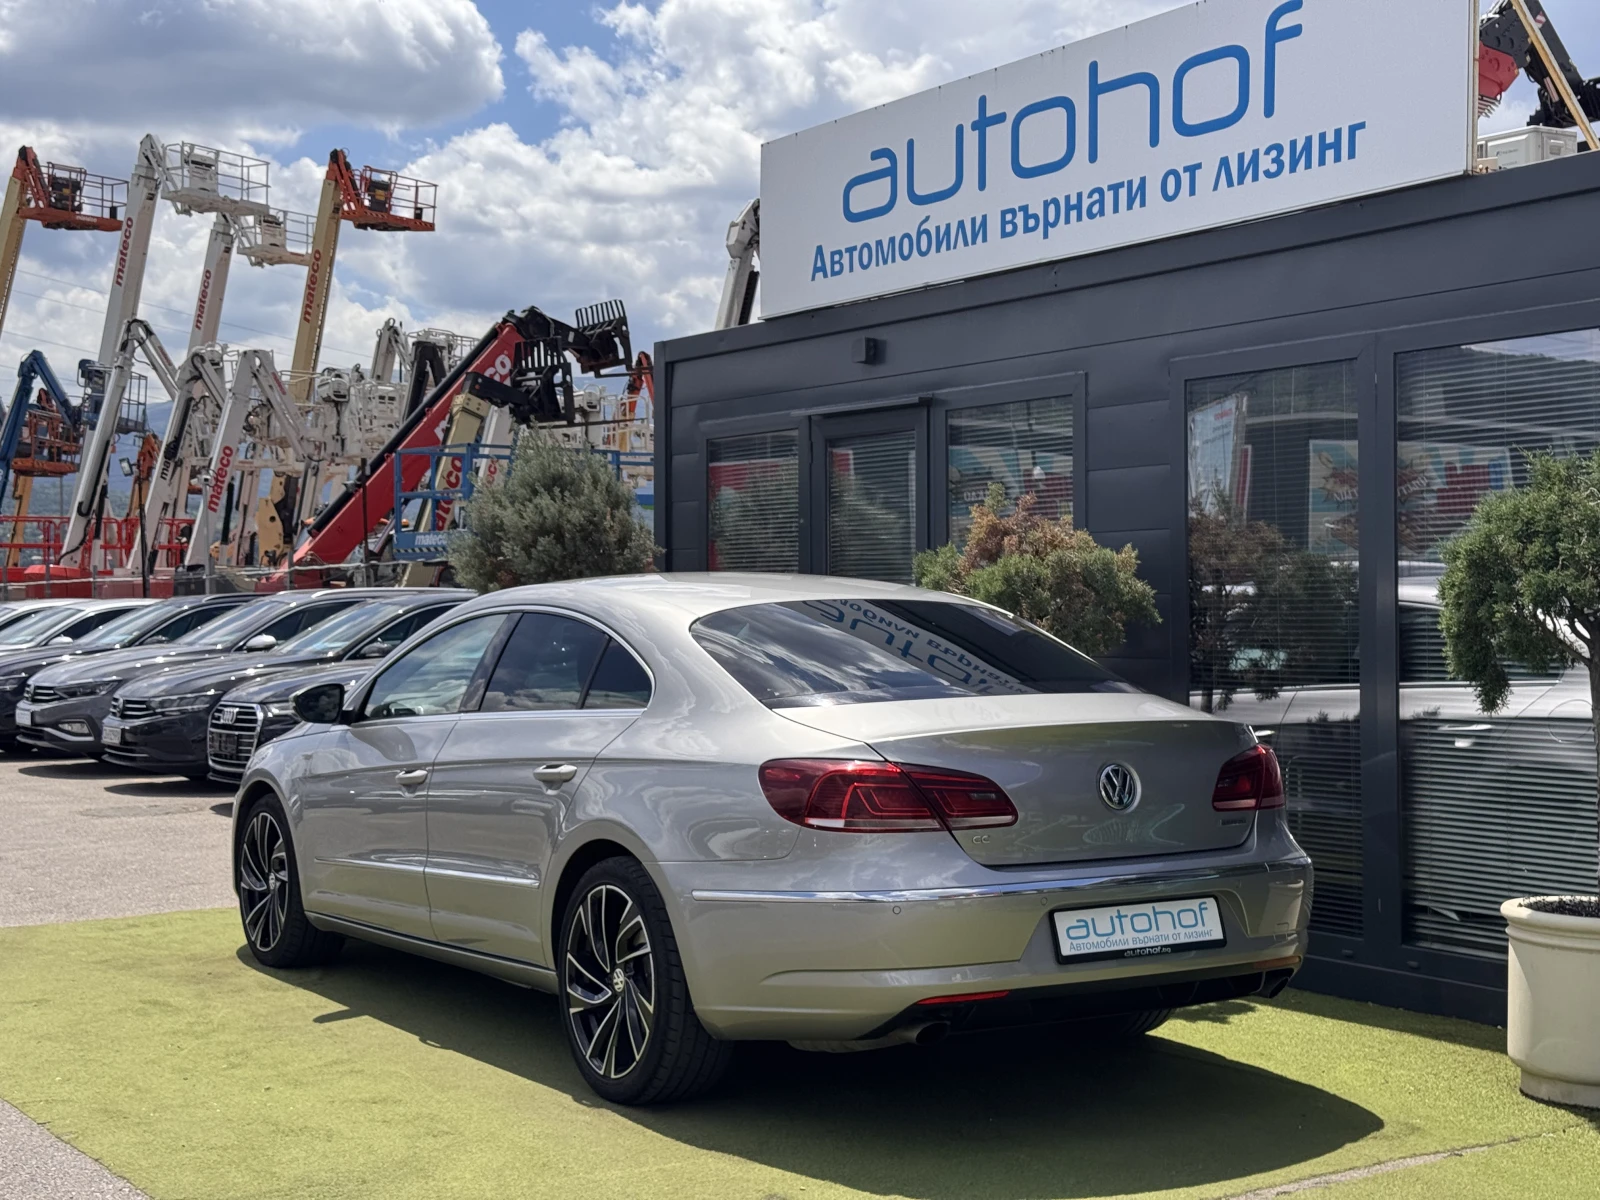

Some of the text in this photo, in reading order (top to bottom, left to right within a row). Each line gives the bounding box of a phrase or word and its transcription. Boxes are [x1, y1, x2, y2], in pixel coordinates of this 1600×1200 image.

[843, 0, 1303, 223] autohof
[811, 121, 1367, 281] Автомобили върнати от лизинг
[115, 216, 134, 288] mateco
[195, 269, 212, 331] mateco
[303, 249, 322, 324] mateco
[207, 446, 234, 514] mateco
[972, 835, 991, 844] CC
[1065, 901, 1209, 940] autohof
[1069, 928, 1213, 952] Автомобили върнати от лизинг
[1124, 946, 1171, 957] autohof.bg
